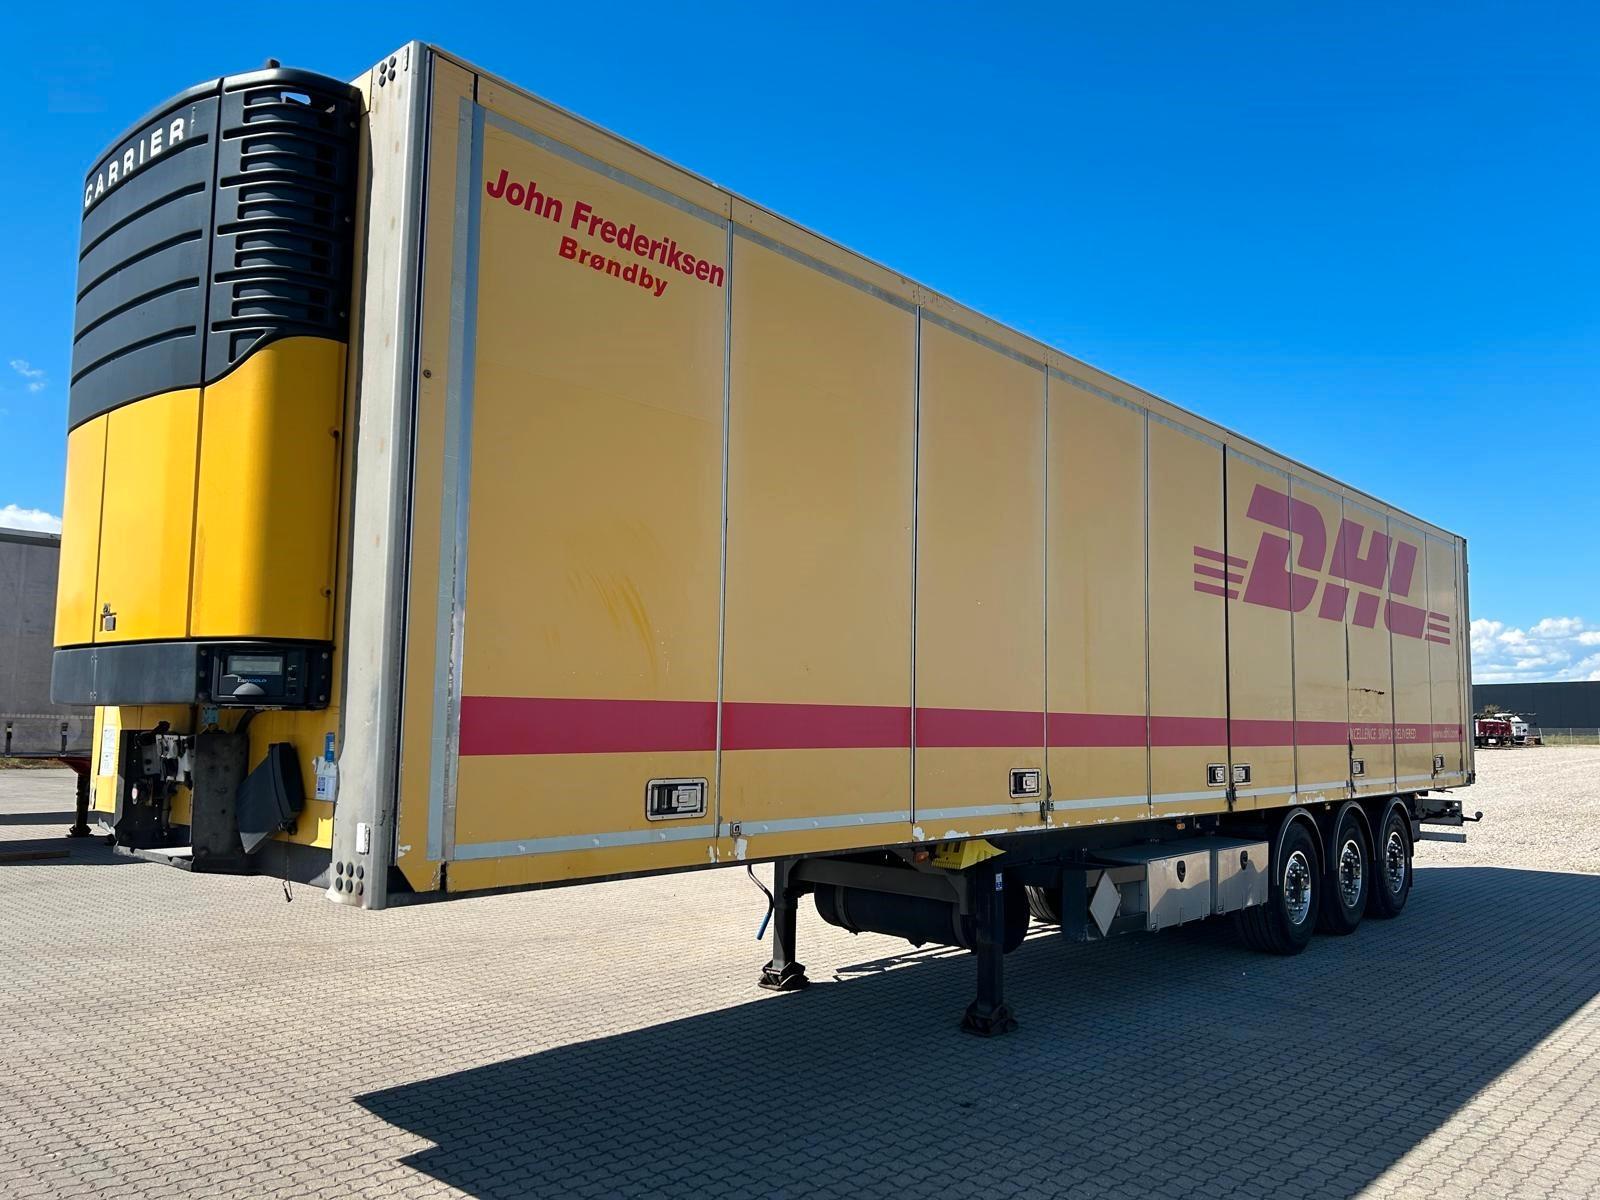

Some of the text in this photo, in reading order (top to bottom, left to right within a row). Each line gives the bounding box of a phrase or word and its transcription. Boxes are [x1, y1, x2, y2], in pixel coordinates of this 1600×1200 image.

[84, 118, 185, 208] CARRIER
[486, 169, 725, 287] John Frederiksen
[558, 235, 669, 297] Brøndby
[1243, 483, 1427, 639] DHL
